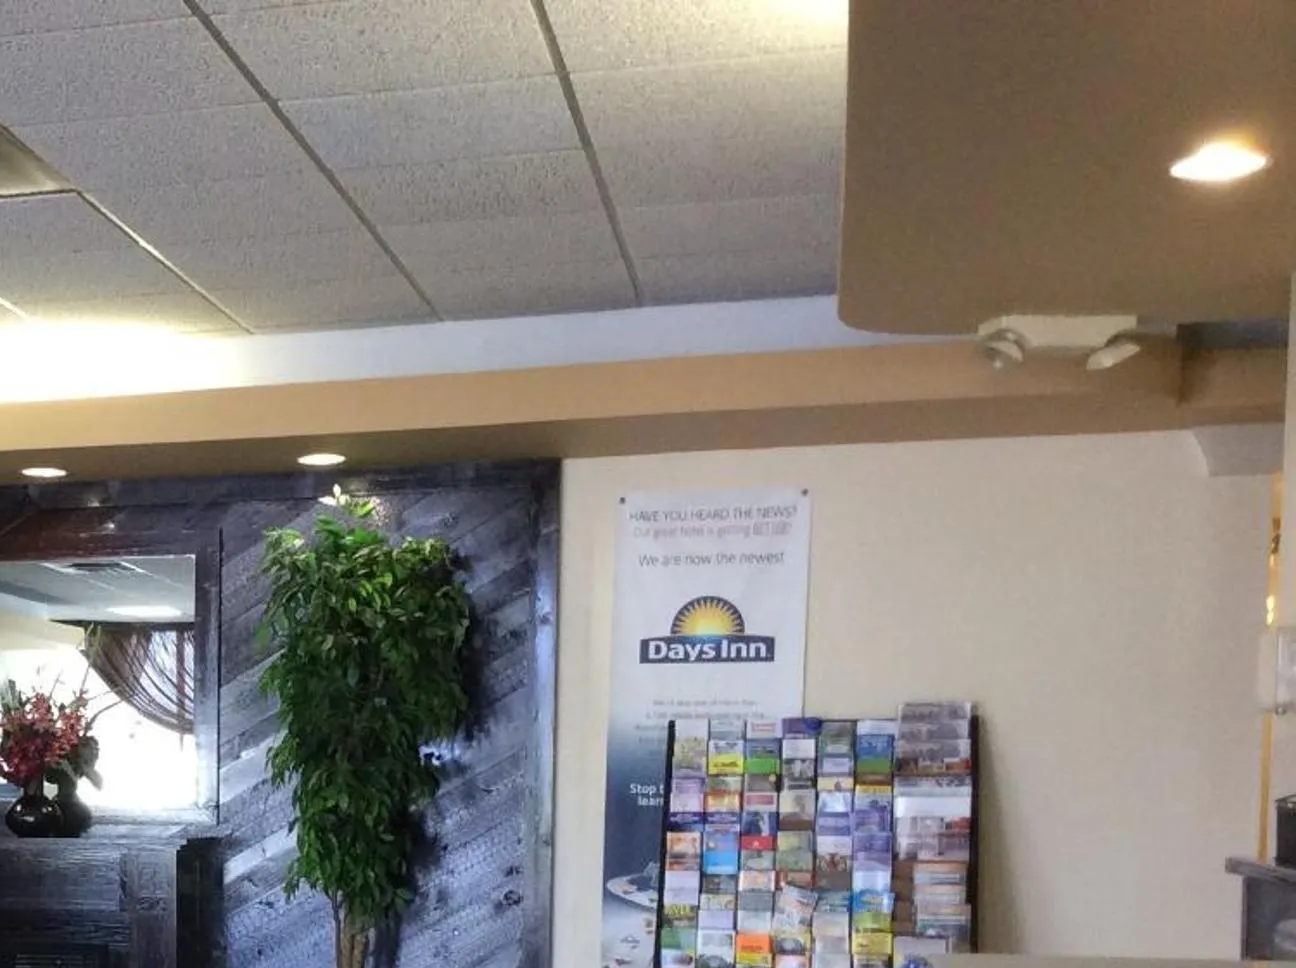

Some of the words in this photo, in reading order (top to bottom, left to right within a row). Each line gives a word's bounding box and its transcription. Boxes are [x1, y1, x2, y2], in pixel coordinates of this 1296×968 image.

[629, 510, 659, 522] HAVE
[661, 510, 687, 521] YOU
[691, 508, 730, 521] HEARD
[733, 507, 753, 520] THE
[638, 554, 660, 568] We
[661, 556, 681, 567] are
[685, 555, 712, 566] now
[716, 552, 736, 564] the
[739, 551, 785, 565] newest
[647, 640, 717, 661] Days
[720, 639, 767, 659] Inn
[629, 783, 657, 796] Stop
